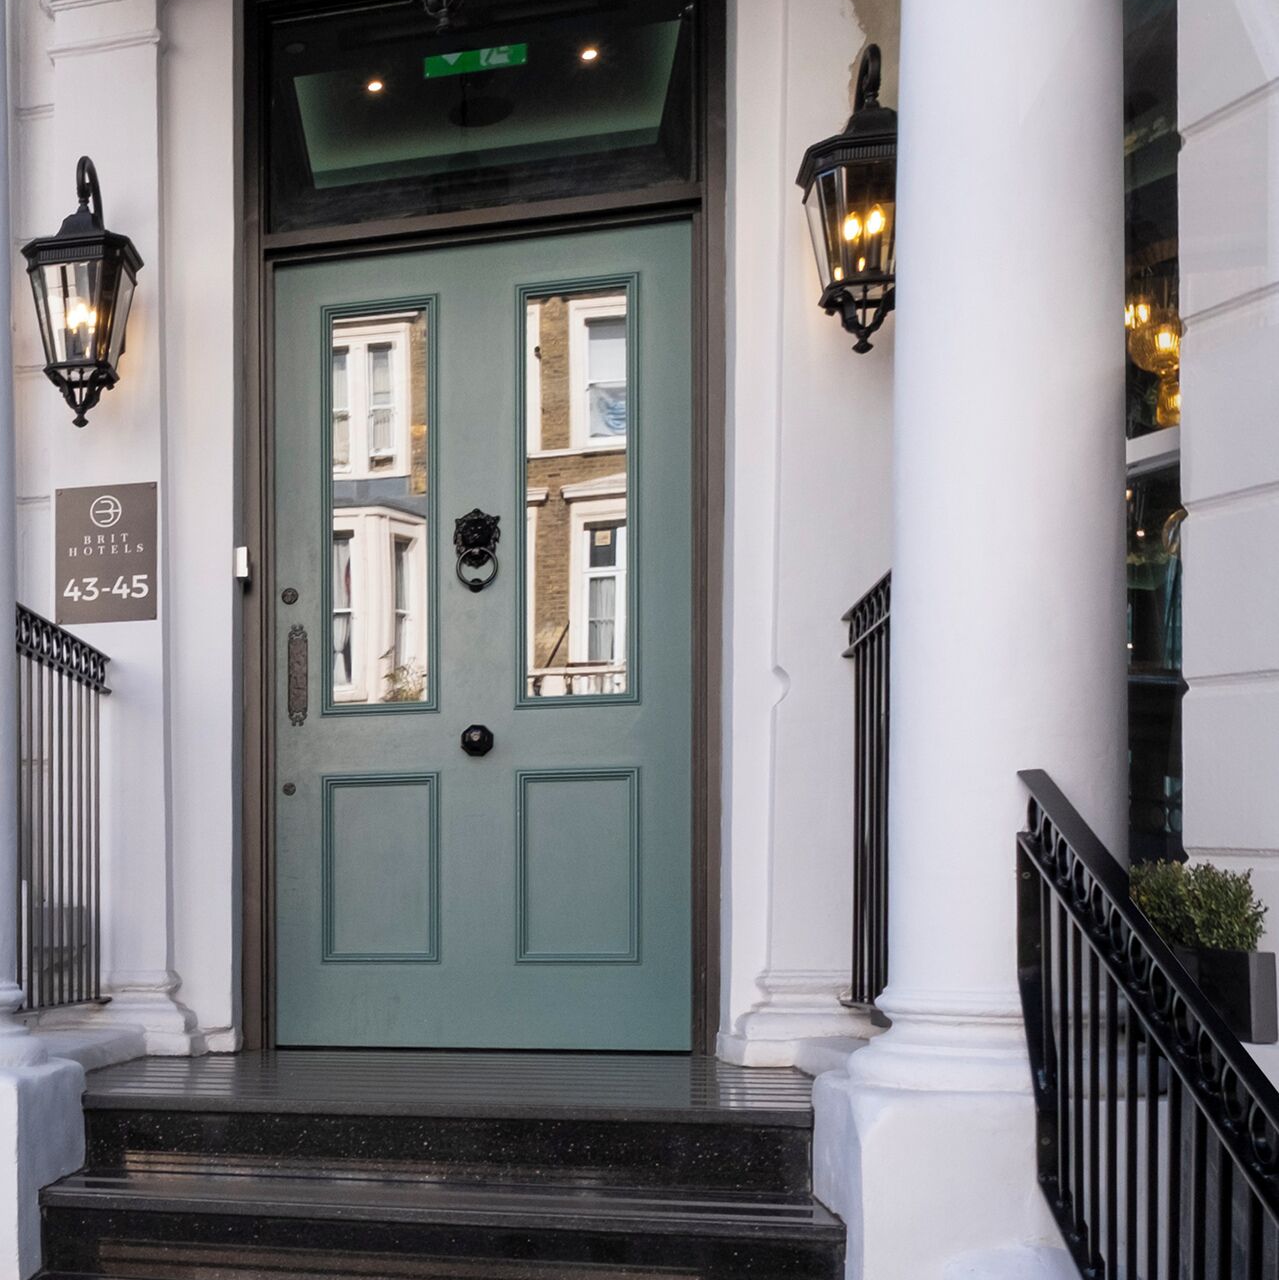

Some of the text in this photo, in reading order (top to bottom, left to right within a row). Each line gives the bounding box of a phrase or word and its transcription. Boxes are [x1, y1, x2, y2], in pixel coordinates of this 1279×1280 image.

[84, 533, 128, 545] BRIT
[69, 543, 144, 557] HOTELS
[63, 574, 149, 602] 43-45
